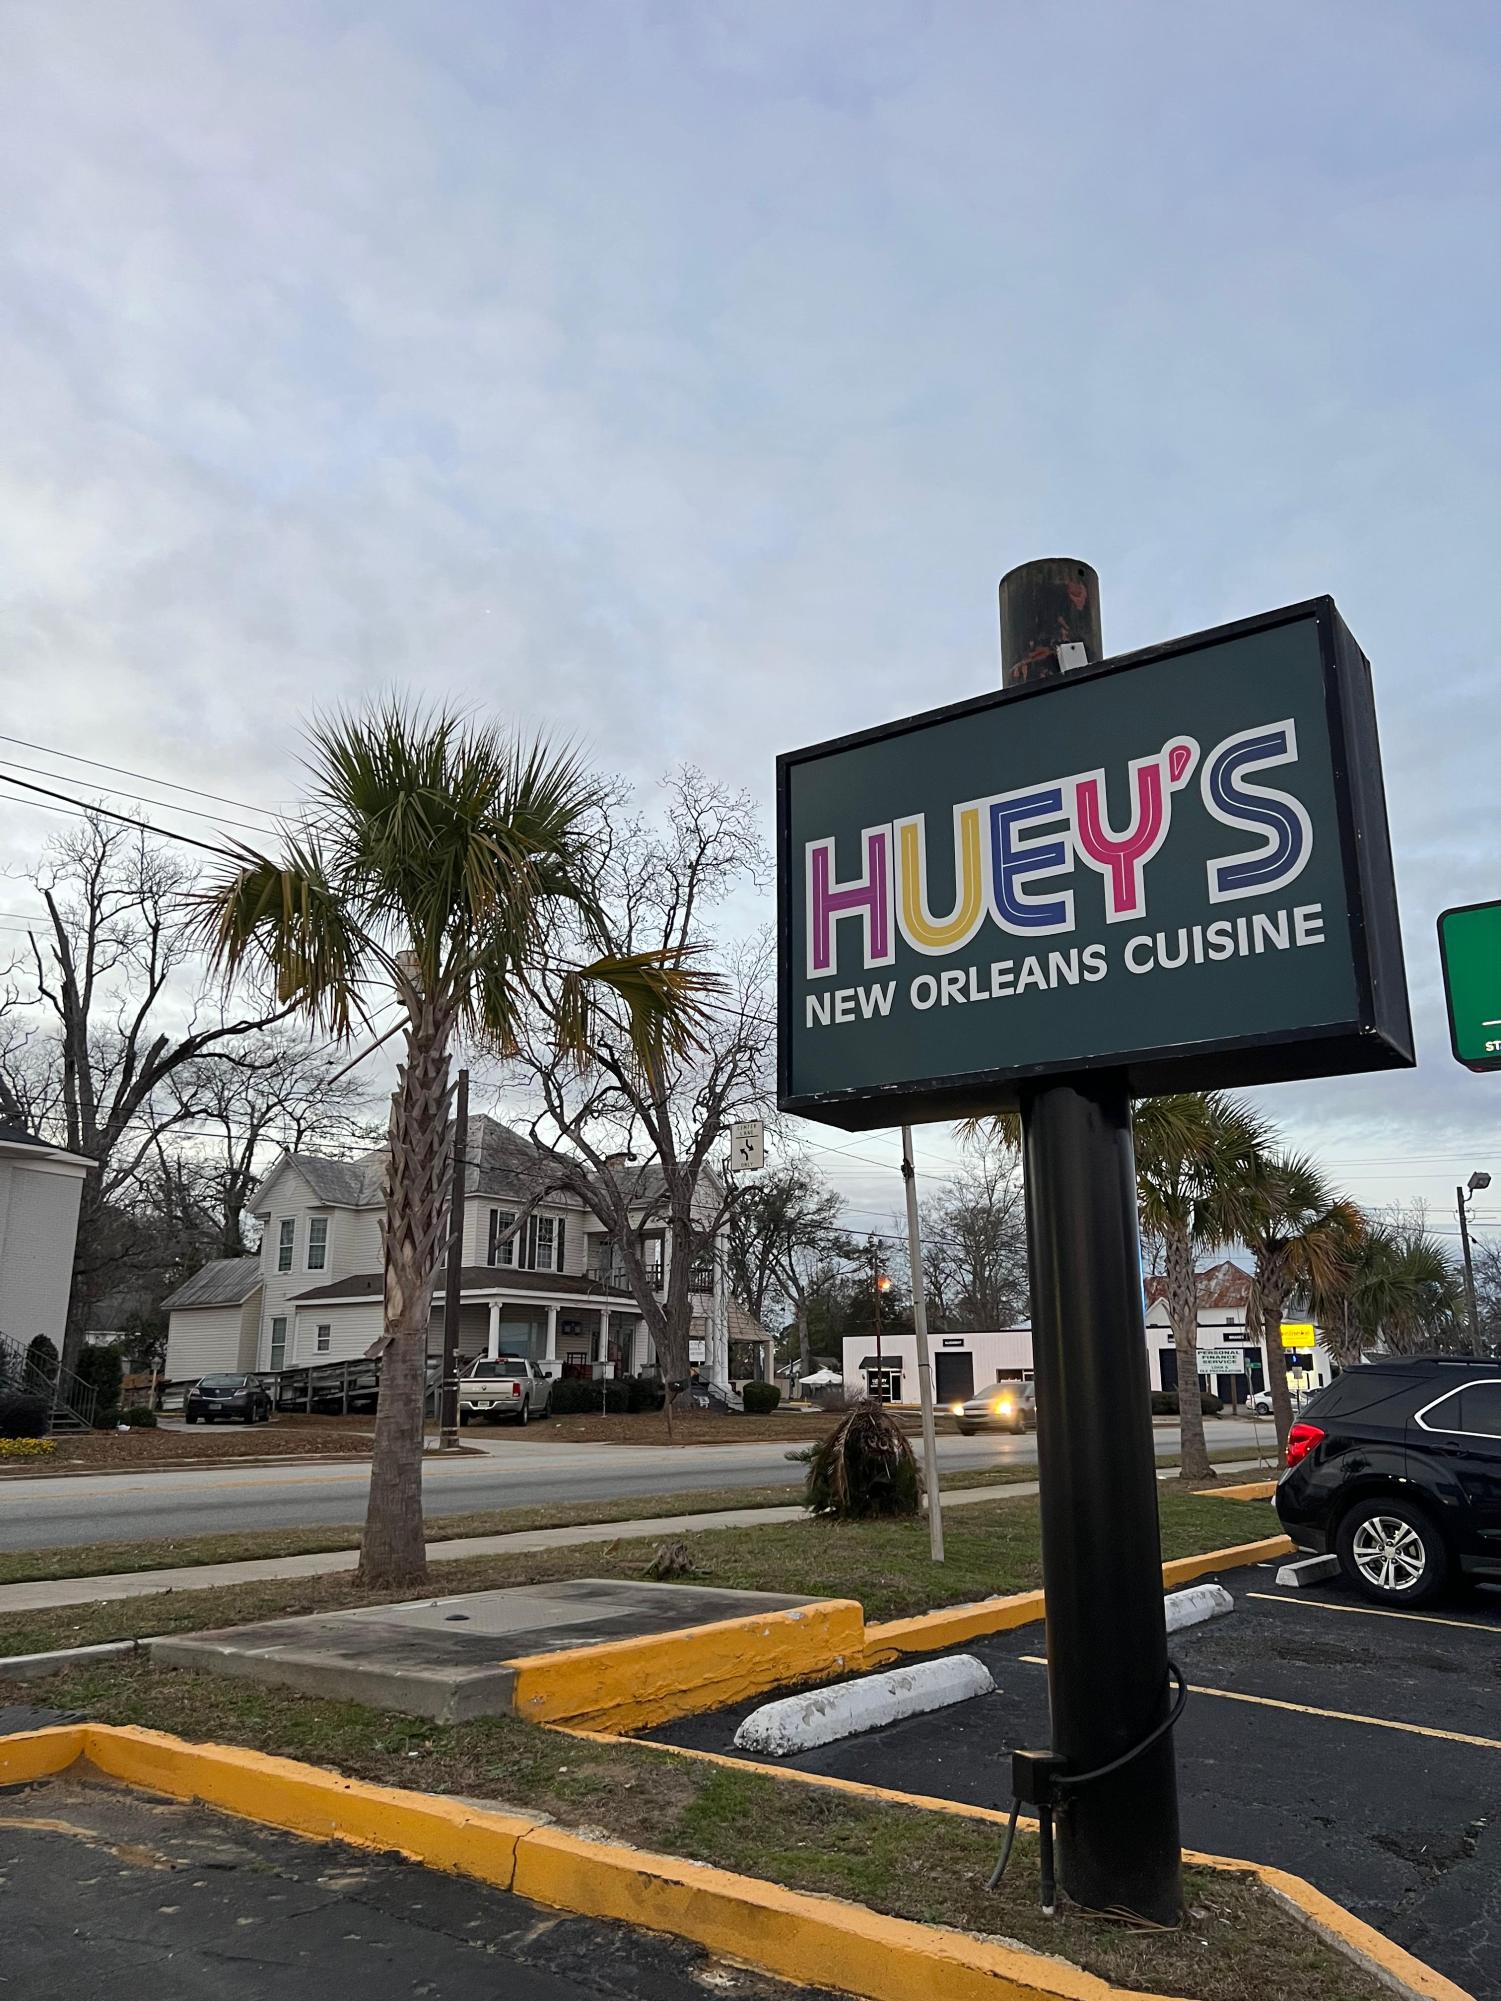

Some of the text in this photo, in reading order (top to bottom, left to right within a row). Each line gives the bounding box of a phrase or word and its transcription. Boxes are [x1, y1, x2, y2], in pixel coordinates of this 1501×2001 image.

[805, 717, 1314, 980] HUEY'S
[805, 903, 1326, 1028] NEW ORLEANS CUISINE
